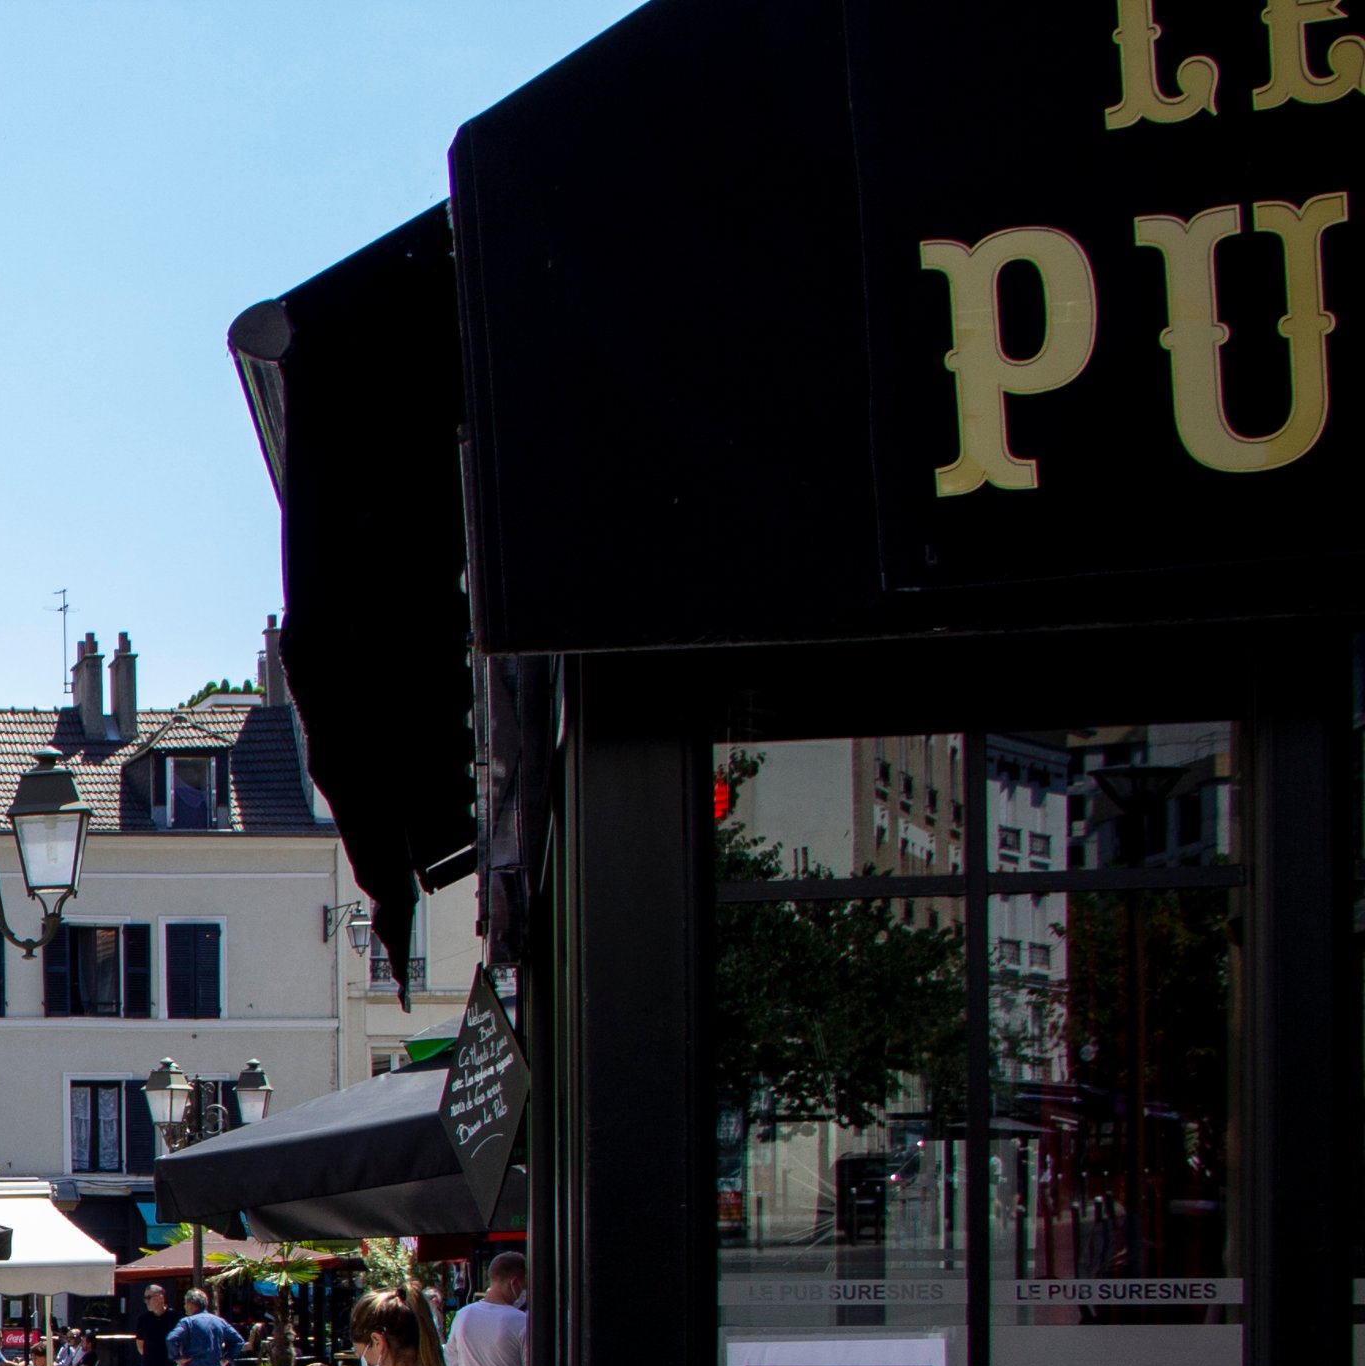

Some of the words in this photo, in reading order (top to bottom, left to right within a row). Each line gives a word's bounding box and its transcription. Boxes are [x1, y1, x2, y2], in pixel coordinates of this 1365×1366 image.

[1105, 0, 1365, 130] LE
[749, 1285, 773, 1302] LE
[780, 1284, 823, 1301] PUB
[828, 1283, 944, 1301] SURESNES
[1016, 1284, 1042, 1301] LE
[1049, 1283, 1093, 1301] PUB
[1098, 1282, 1217, 1301] SURESNES
